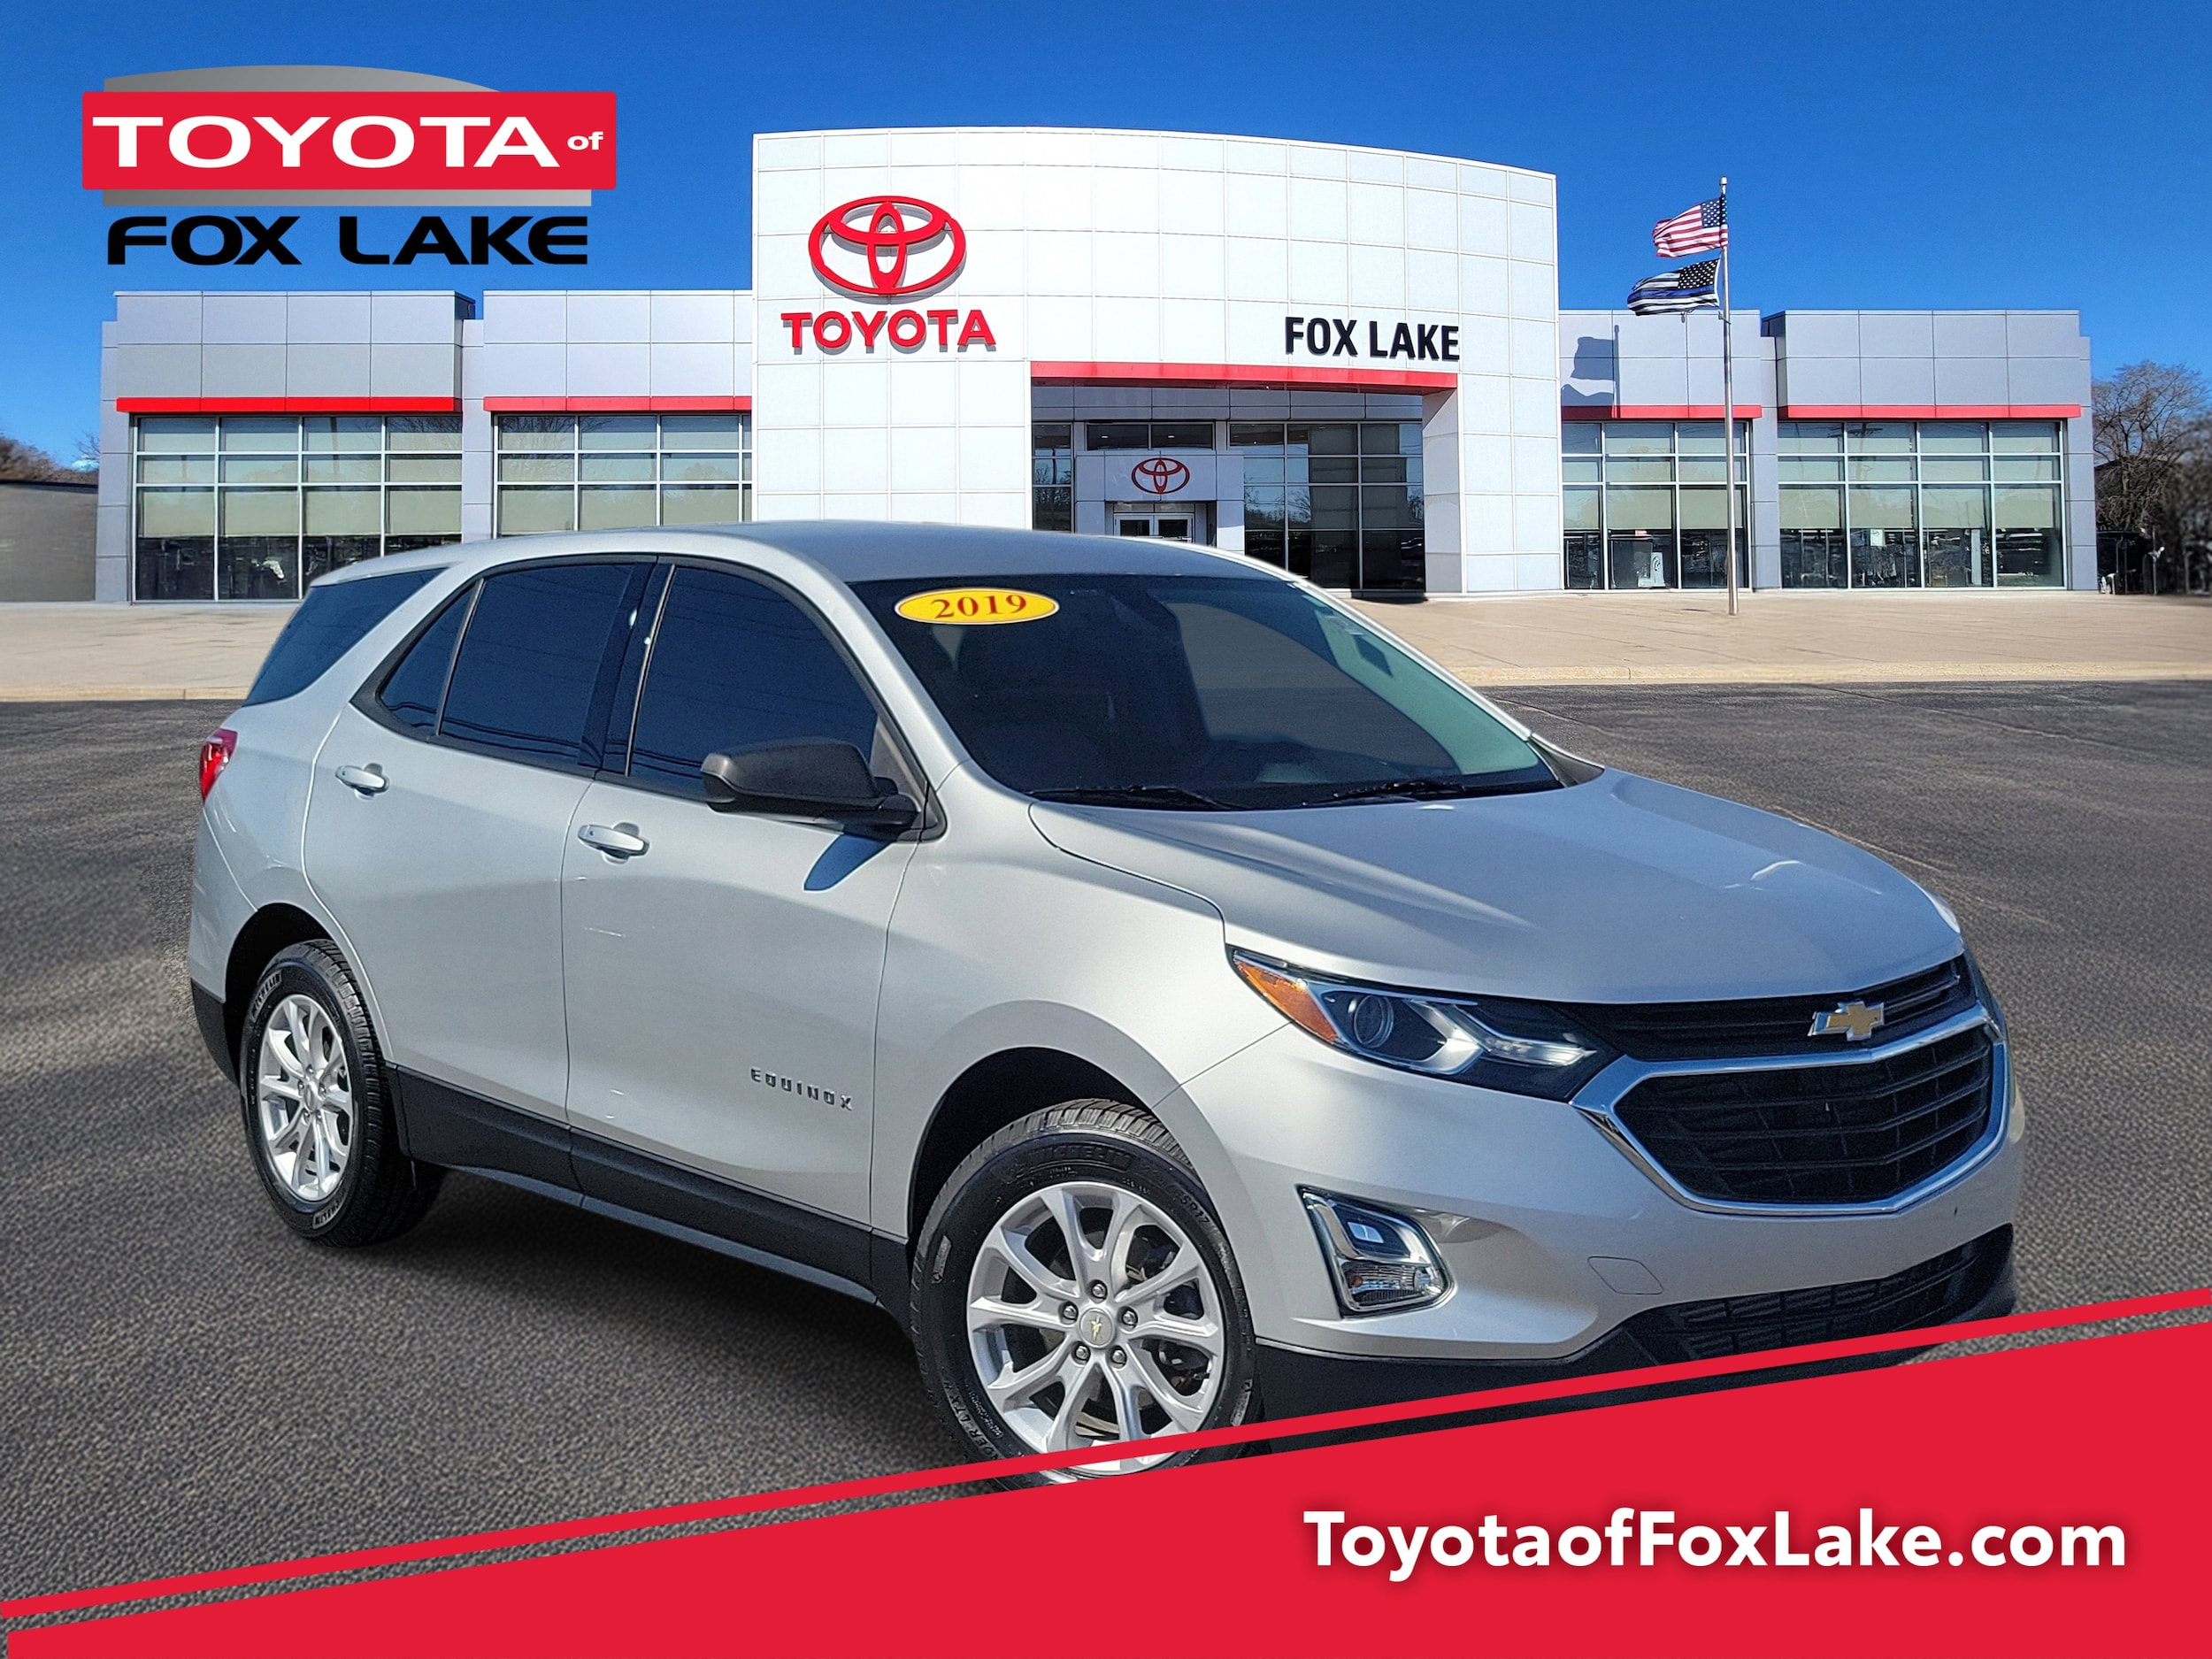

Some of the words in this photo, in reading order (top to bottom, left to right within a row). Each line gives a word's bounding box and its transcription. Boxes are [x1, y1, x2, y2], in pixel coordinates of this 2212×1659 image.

[780, 309, 997, 354] TOYOTA
[1285, 316, 1358, 357] FOX
[1369, 320, 1460, 361] LAKE
[931, 594, 1027, 619] 2019
[750, 1067, 853, 1111] EQUINOX
